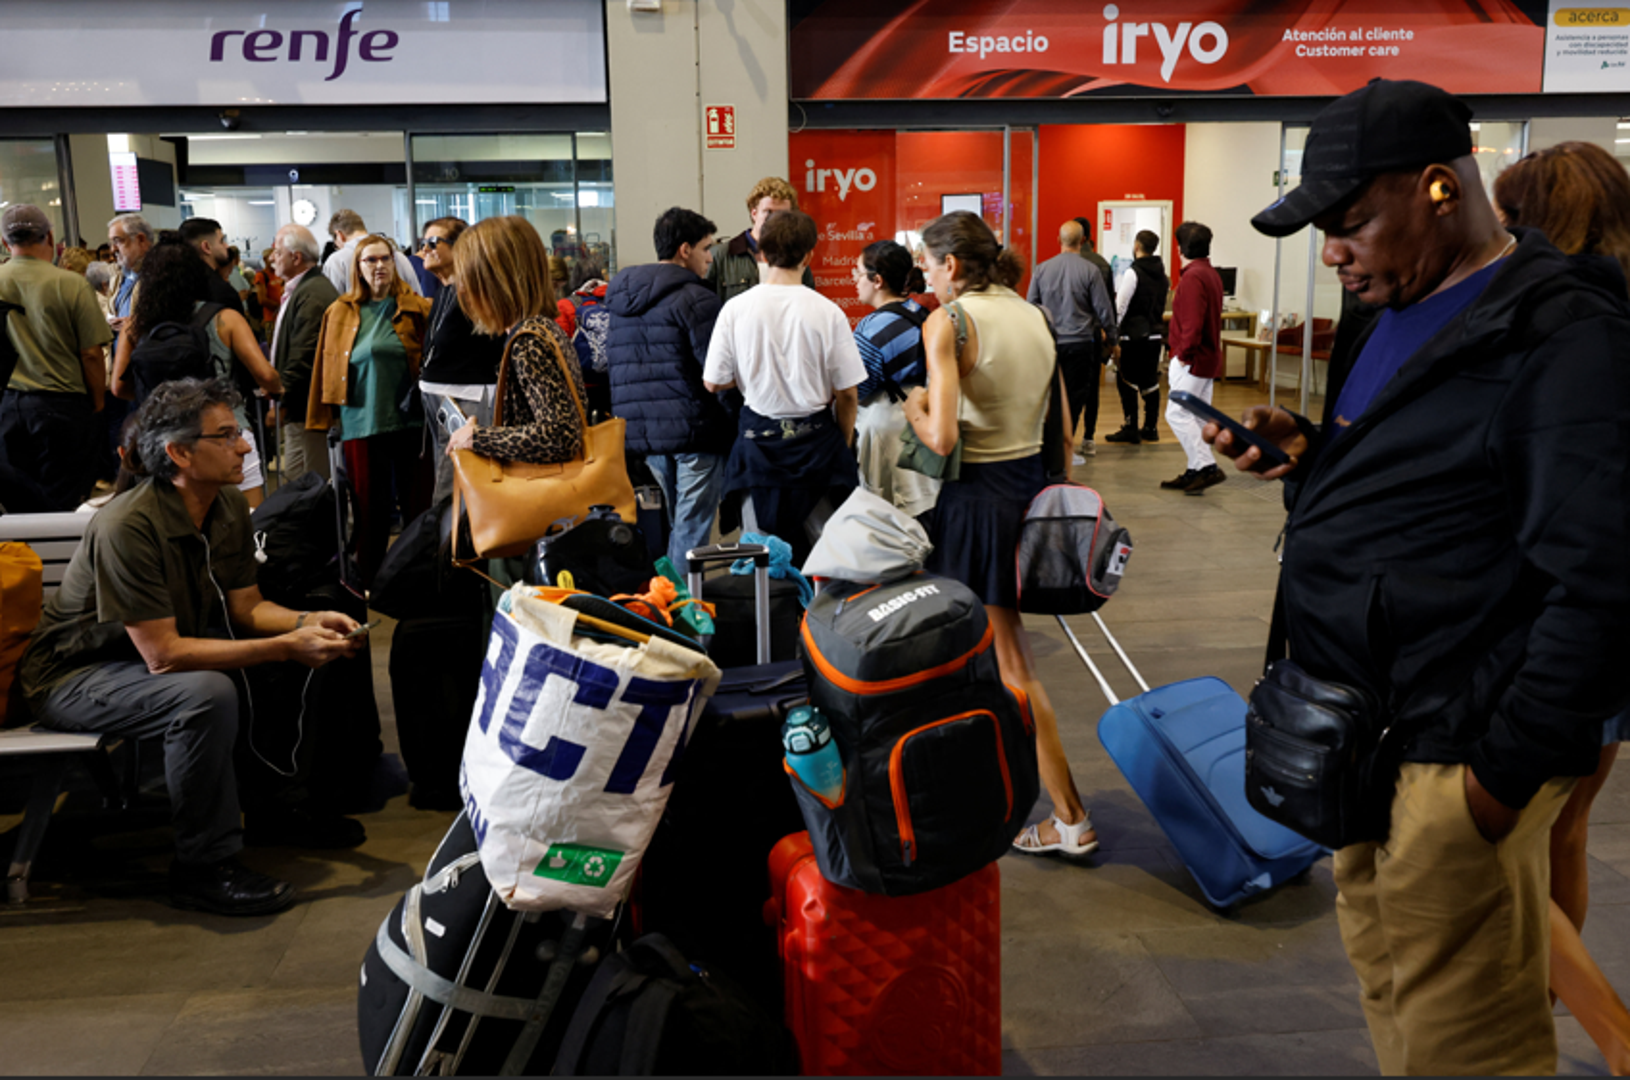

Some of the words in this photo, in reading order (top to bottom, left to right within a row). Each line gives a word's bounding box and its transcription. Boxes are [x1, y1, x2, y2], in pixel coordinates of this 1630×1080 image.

[1568, 11, 1619, 23] acerca
[1282, 26, 1346, 41] Atención
[1349, 26, 1363, 41] al
[1365, 26, 1414, 41] cliente
[210, 8, 399, 81] renfe
[949, 30, 1049, 59] Espacio
[1102, 3, 1229, 83] iryo
[1295, 44, 1366, 57] Customer
[1368, 46, 1400, 57] care
[805, 158, 877, 202] iryo
[828, 230, 864, 241] Sevilla
[814, 275, 857, 287] Barcelo
